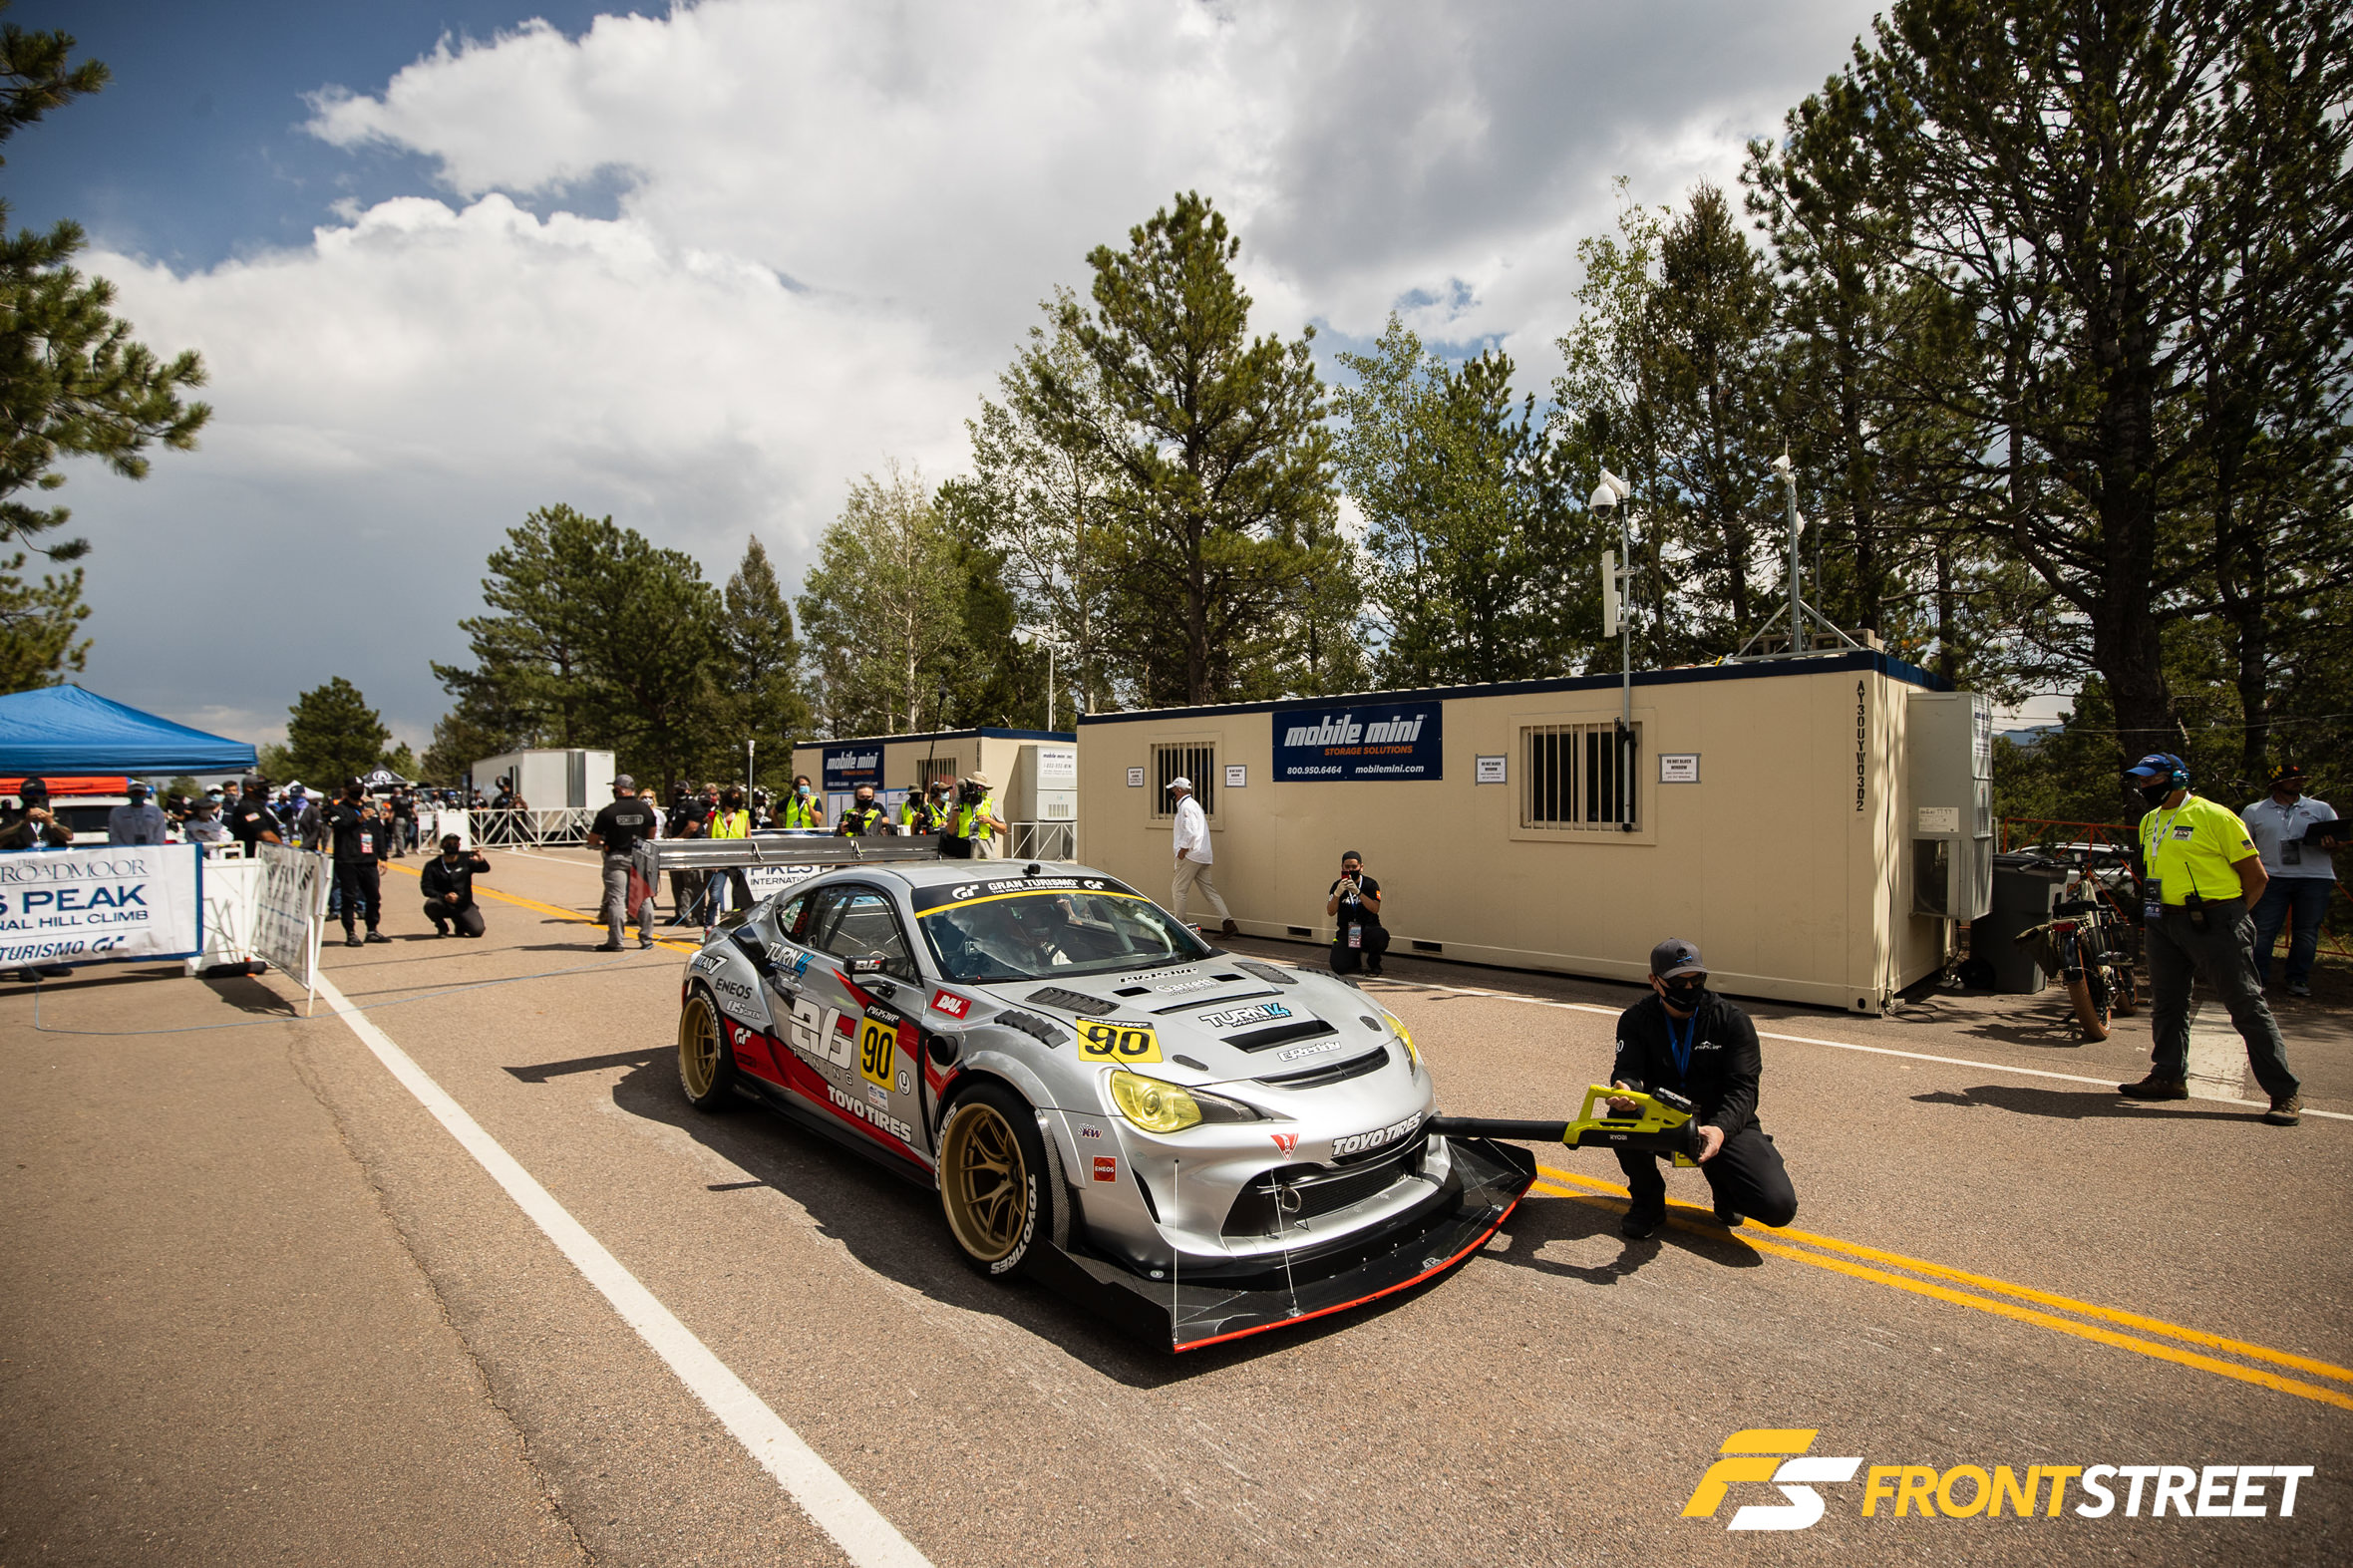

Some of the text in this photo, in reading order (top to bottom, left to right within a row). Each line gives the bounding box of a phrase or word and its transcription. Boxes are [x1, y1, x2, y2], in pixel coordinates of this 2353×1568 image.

[1284, 714, 1424, 747] mobile mini
[827, 751, 878, 770] mobile mini
[1324, 746, 1413, 757] STORAGE SOLUTIONS
[1287, 764, 1424, 775] 800.950.6464 mobilemini.com
[987, 878, 1078, 891] GRAN TURISMO
[23, 884, 148, 914] PEAK
[39, 915, 83, 928] HILL
[87, 910, 149, 924] CLIMB
[0, 940, 85, 961] TURISMO
[715, 978, 753, 1000] ENEOS
[1156, 978, 1217, 993] Garrett
[1198, 1003, 1293, 1027] TURN14
[862, 1026, 893, 1080] 90
[1085, 1026, 1151, 1056] 90
[792, 1047, 853, 1086] TUNING
[827, 1084, 864, 1118] TOYO
[865, 1104, 912, 1143] TIRES
[1331, 1110, 1423, 1156] TOYO TIRES
[990, 1173, 1037, 1275] TOYO TIRES
